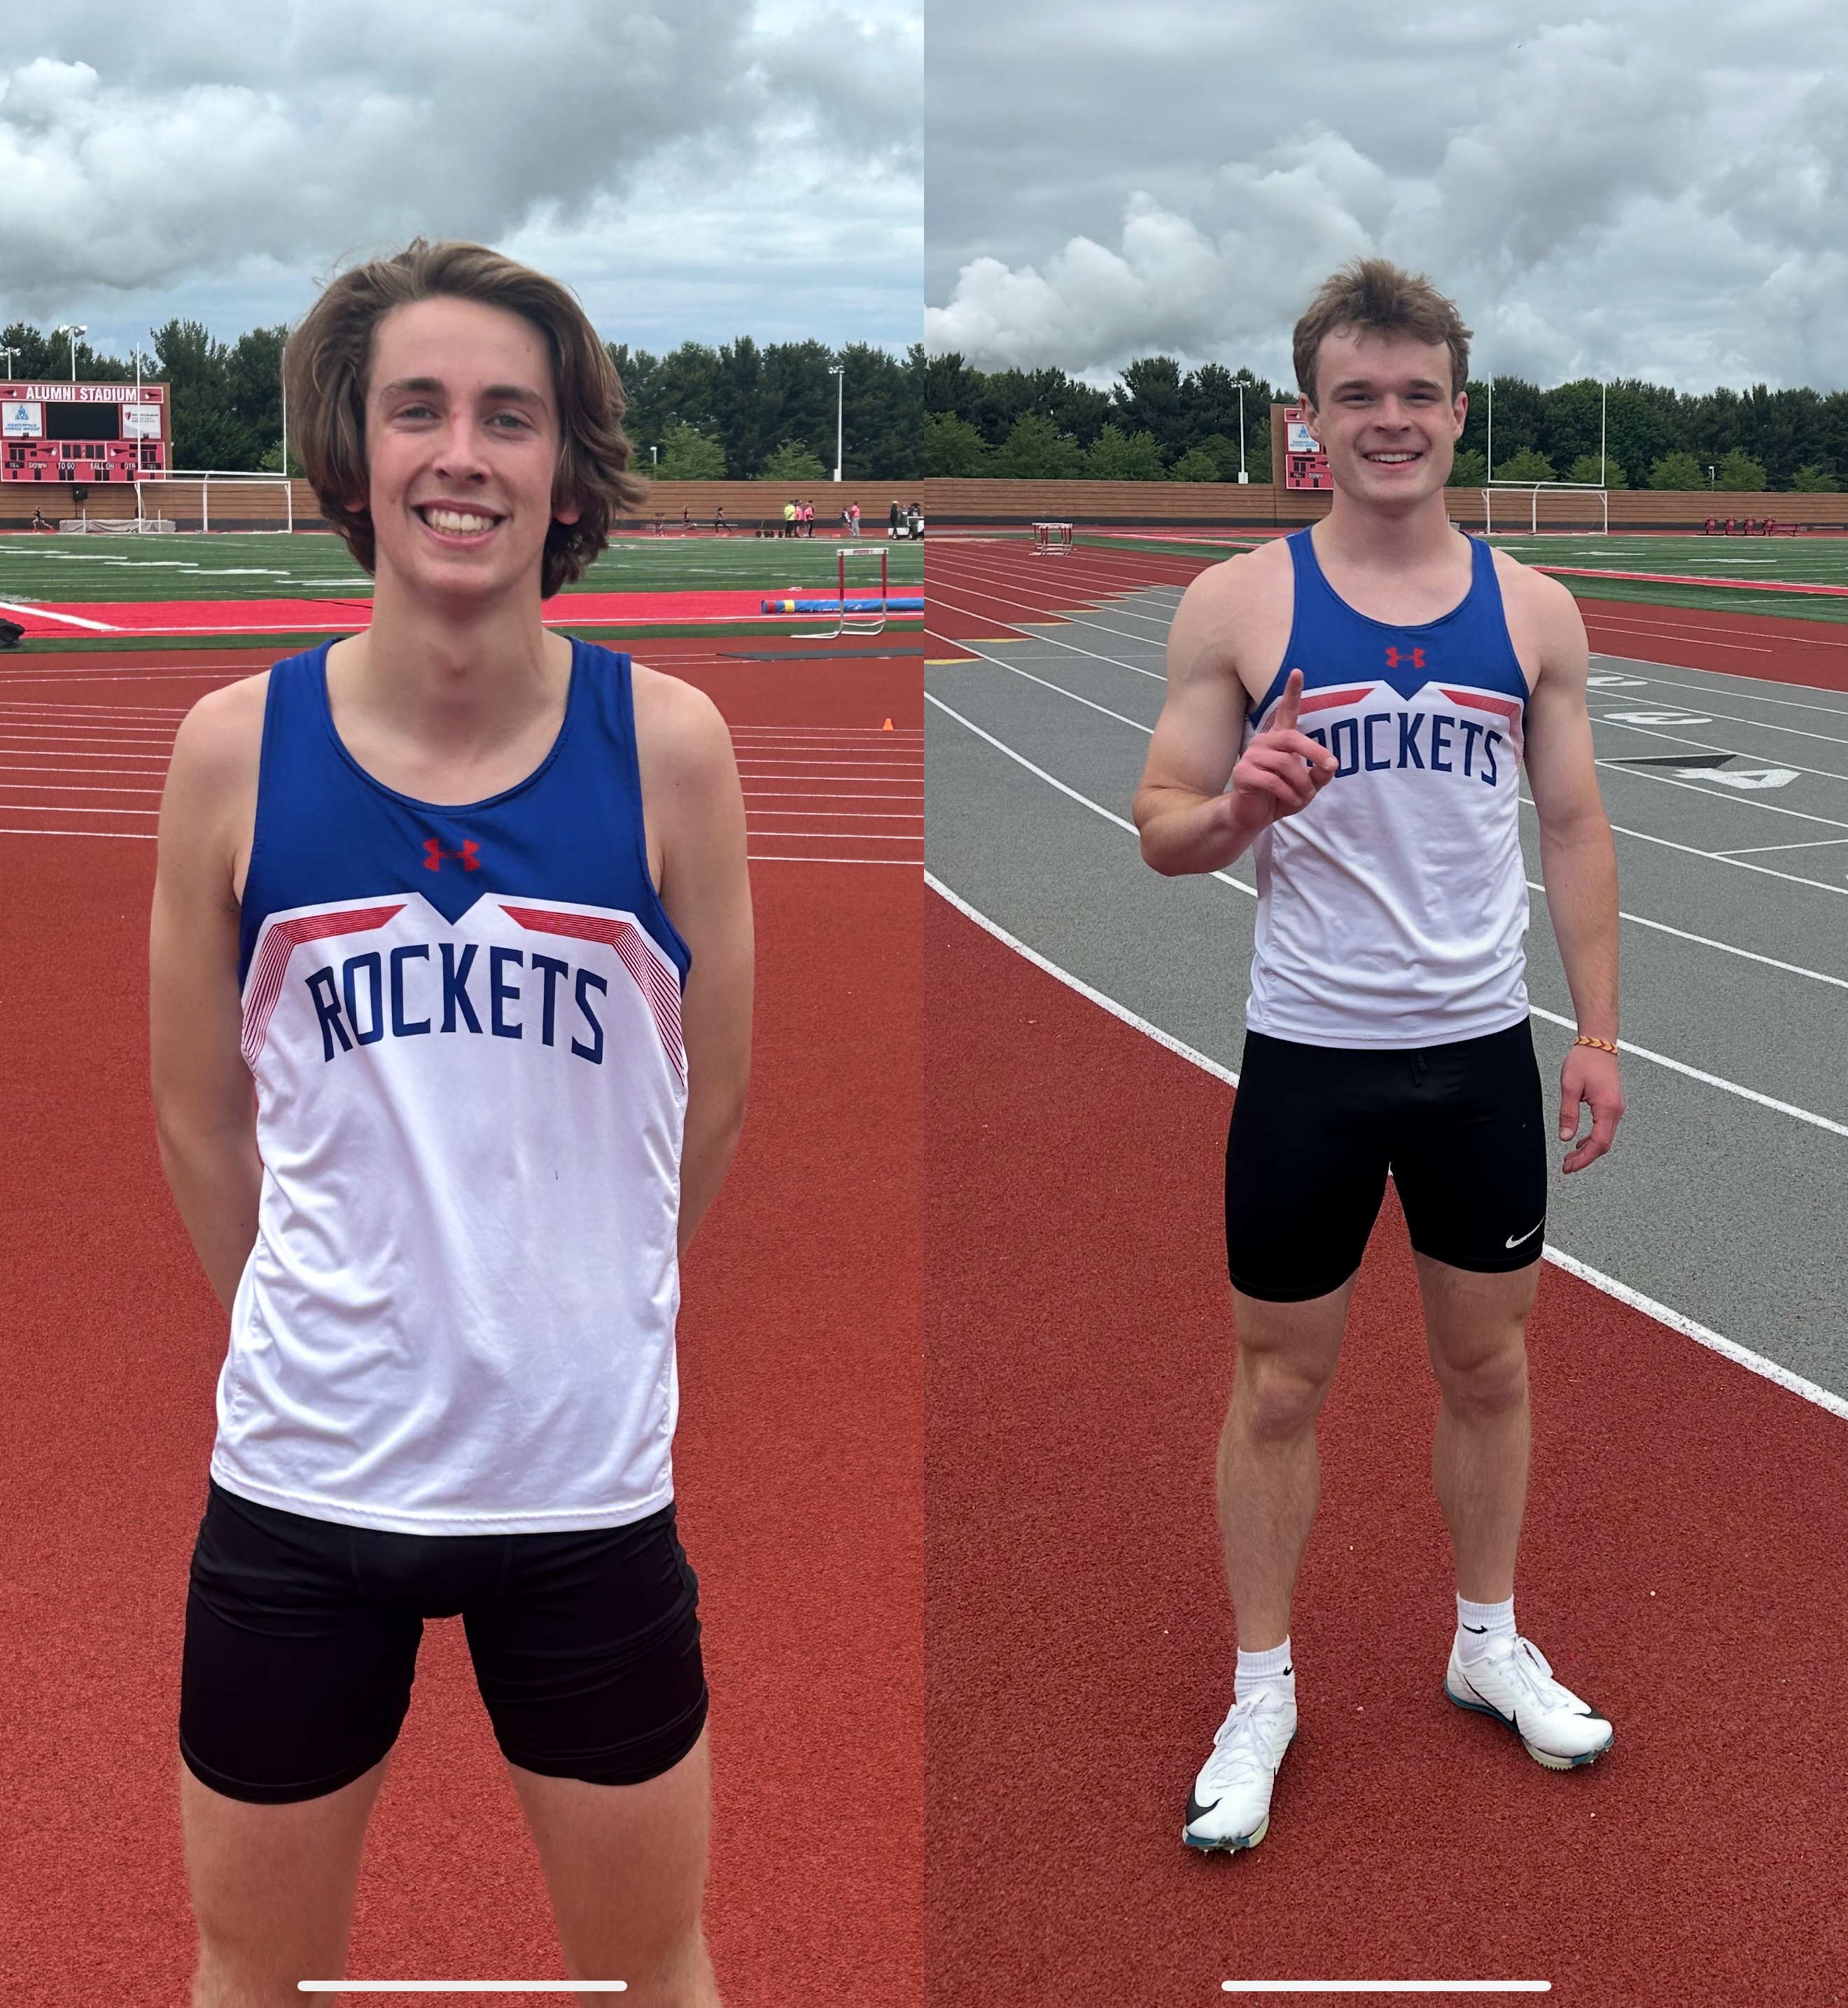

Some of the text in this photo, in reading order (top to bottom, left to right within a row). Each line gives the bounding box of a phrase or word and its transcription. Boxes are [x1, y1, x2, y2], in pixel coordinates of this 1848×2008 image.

[26, 386, 137, 402] ALUMNI STADIUM
[1603, 712, 1713, 725] 3
[1672, 767, 1802, 790] 4
[304, 942, 608, 1065] ROCKETS
